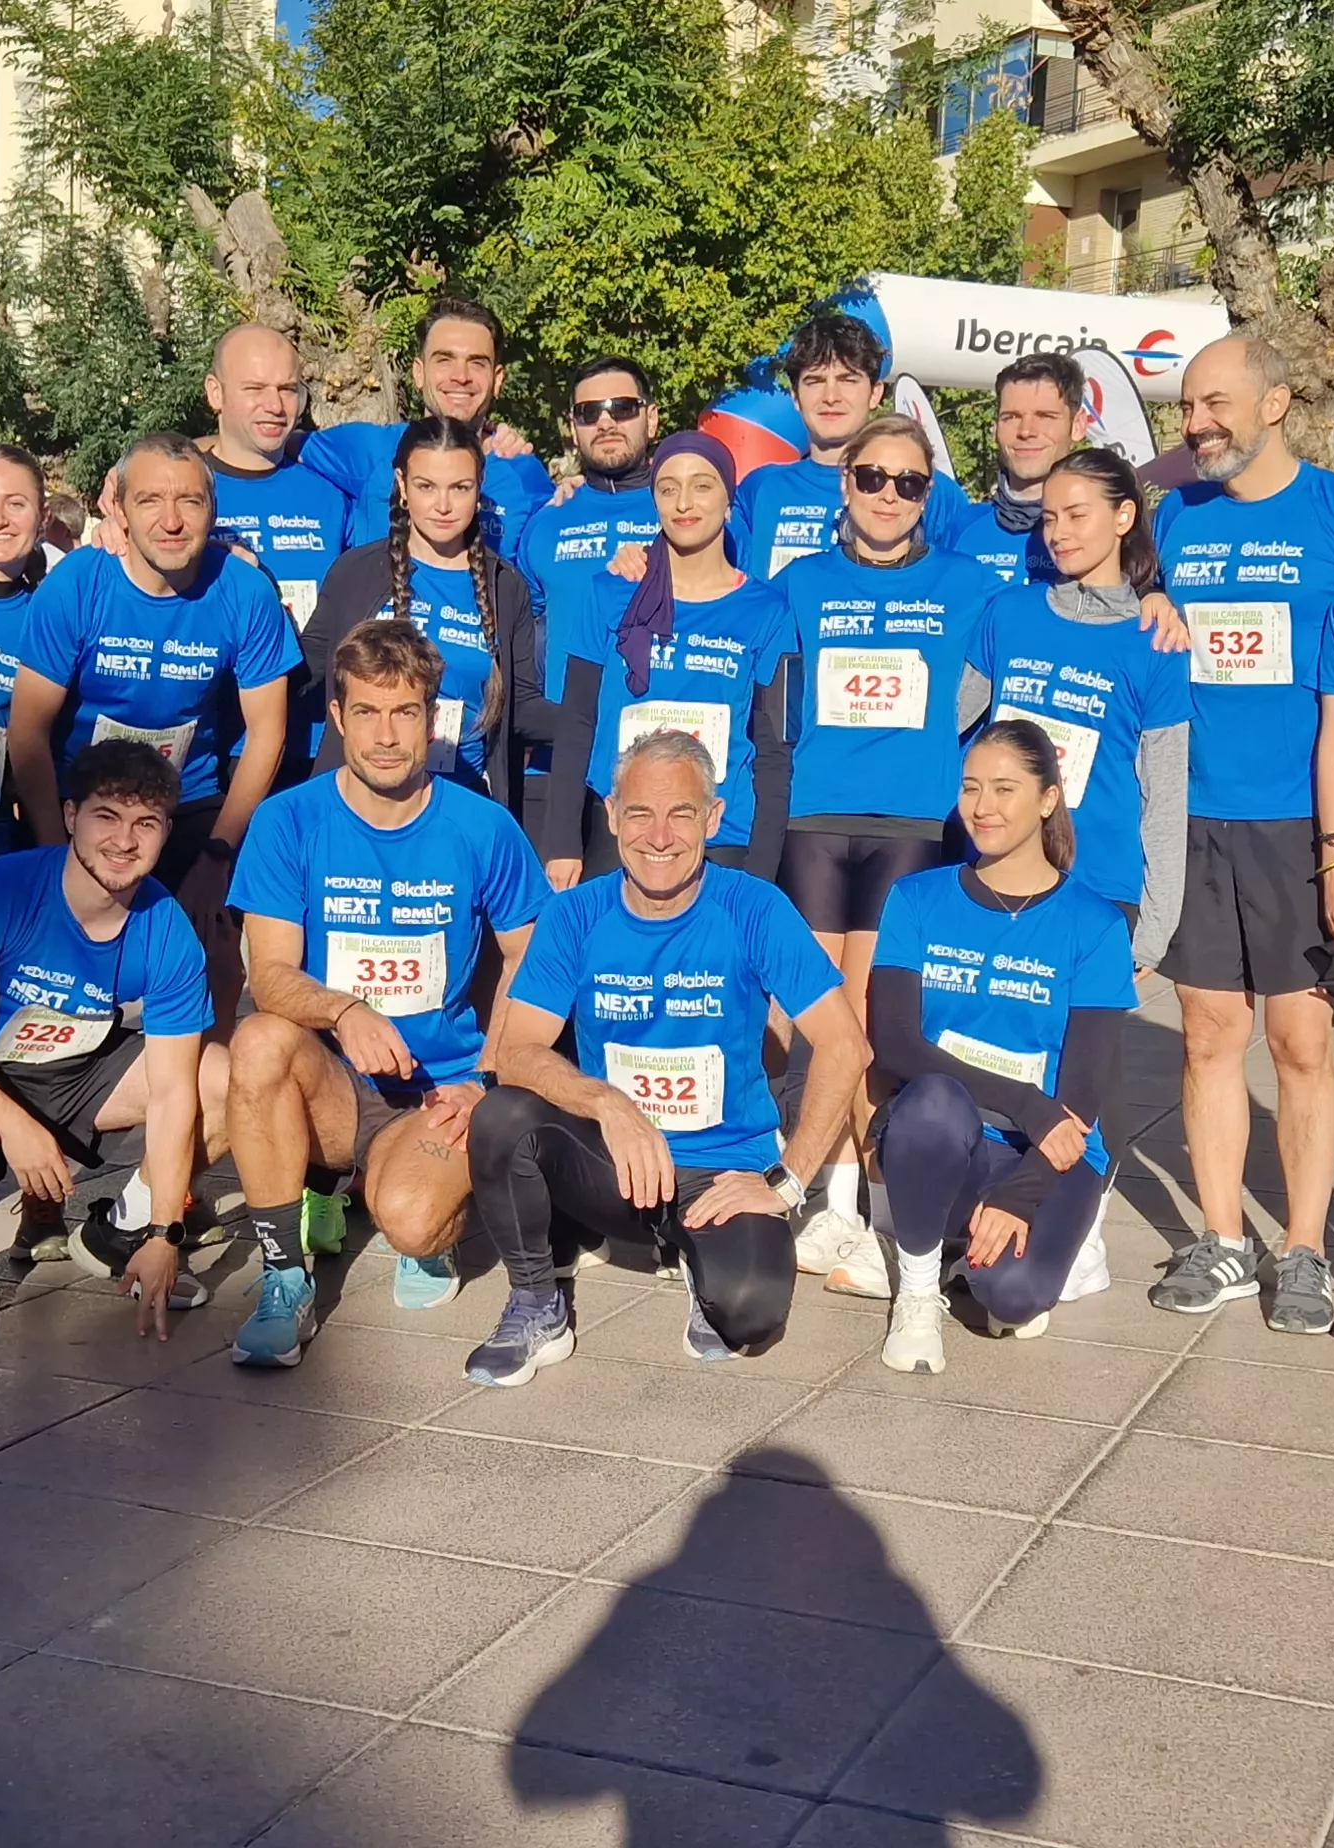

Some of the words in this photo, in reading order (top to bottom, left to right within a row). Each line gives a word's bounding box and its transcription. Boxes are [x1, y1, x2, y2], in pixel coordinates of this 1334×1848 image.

[780, 506, 827, 516] MEDIAZION
[215, 516, 259, 528] EDIAZION
[281, 515, 321, 528] kablex
[560, 522, 607, 536] MEDIAZION
[776, 523, 823, 536] NEXT
[273, 535, 309, 545] HOME
[556, 538, 606, 554] NEXT
[1181, 544, 1232, 555] MEDIAZION
[1254, 541, 1304, 557] kablex
[1175, 561, 1227, 578] NEXT
[1238, 565, 1277, 576] HOME
[822, 600, 875, 611] MEDIAZION
[900, 599, 944, 613] kablex
[820, 616, 874, 631] NEXT
[887, 619, 926, 628] HOME
[440, 627, 477, 643] HOME
[99, 636, 153, 650] MEDIAZION
[175, 640, 218, 657] kablex
[702, 635, 746, 655] kablex
[1209, 631, 1263, 655] 532
[97, 652, 151, 672] NEXT
[686, 654, 723, 668] HOME
[1009, 658, 1054, 672] MEDIAZION
[1216, 659, 1256, 668] DAVID
[161, 663, 197, 676] HOME
[1216, 670, 1233, 681] 8K
[844, 675, 901, 697] 423
[1002, 677, 1047, 695] NEXT
[1071, 667, 1114, 692] kablex
[1053, 689, 1089, 706] HOME
[850, 702, 893, 710] HELEN
[849, 712, 867, 723] 8K
[325, 876, 381, 889] MEDIAZION
[405, 880, 454, 897] kablex
[324, 897, 381, 915] NEXT
[392, 907, 433, 919] HOME
[372, 939, 422, 947] CARRERA
[927, 944, 985, 963] MEDIAZION
[18, 964, 75, 985] MEDIAZION
[356, 959, 420, 982] 333
[922, 962, 980, 985] NEXT
[1008, 956, 1056, 978] kablex
[594, 973, 653, 986] MEDIAZION
[679, 970, 725, 988] kablex
[989, 978, 1029, 994] HOME
[10, 979, 69, 1009] NEXT
[352, 985, 422, 995] ROBERTO
[595, 992, 653, 1012] NEXT
[666, 999, 703, 1011] HOME
[16, 1023, 75, 1043] 528
[15, 1044, 55, 1052] DIEGO
[977, 1050, 1022, 1068] CARRERA
[633, 1075, 697, 1100] 332
